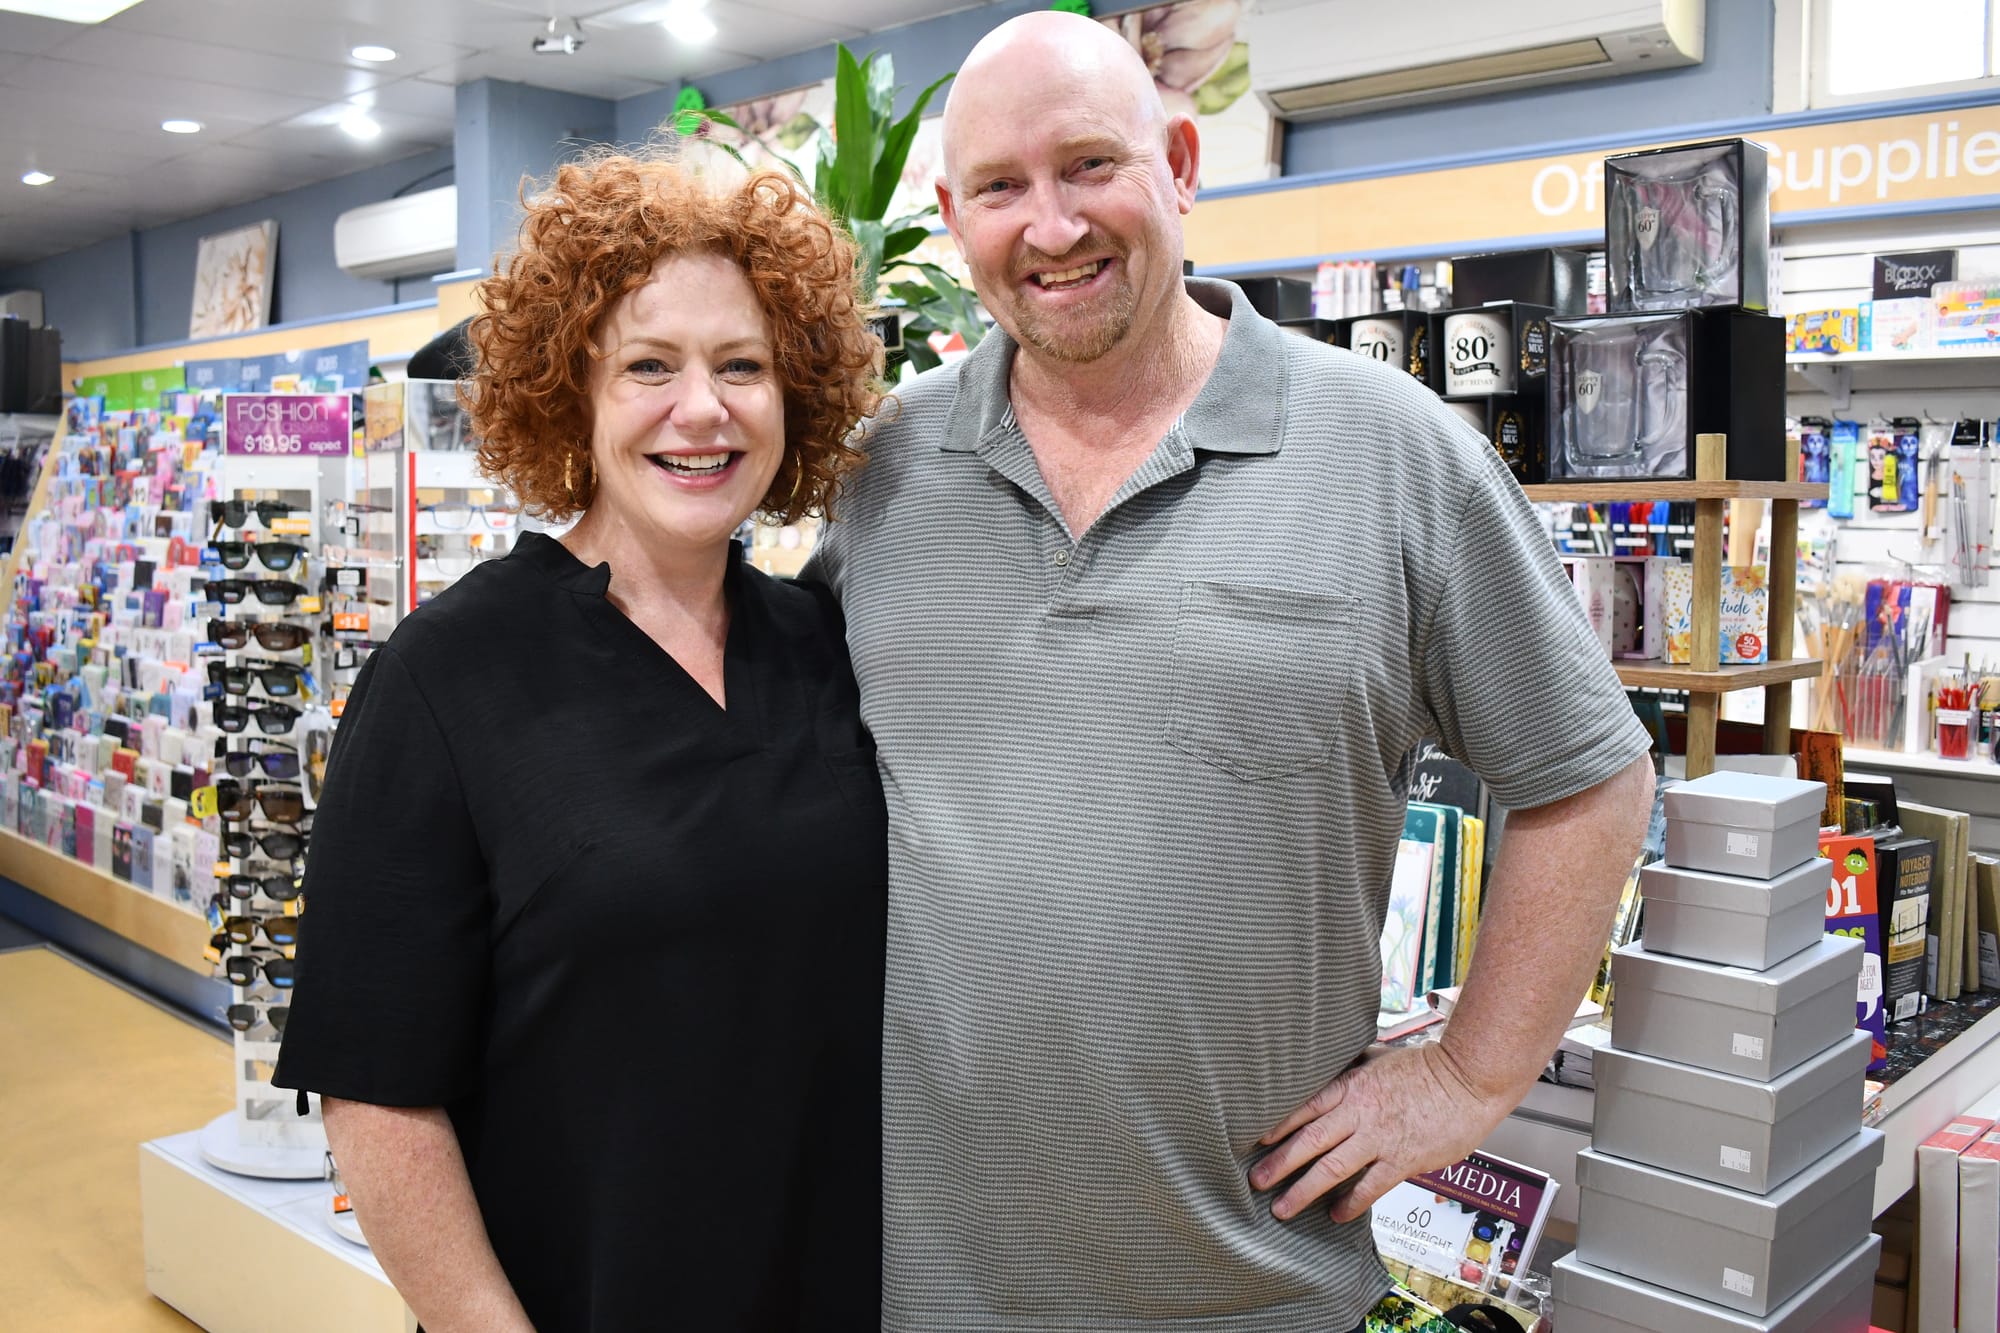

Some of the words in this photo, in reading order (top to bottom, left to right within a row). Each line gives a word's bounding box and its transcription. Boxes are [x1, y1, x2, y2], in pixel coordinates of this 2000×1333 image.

[1531, 164, 1604, 217] Of
[1455, 335, 1489, 361] 80
[244, 434, 302, 453] $19.95
[1743, 635, 1755, 646] 50
[1900, 854, 1931, 875] VOYAGER
[1899, 870, 1930, 889] NOTEBOOK
[1440, 1164, 1521, 1209] MEDIA
[1406, 1206, 1432, 1229] 60
[1376, 1213, 1454, 1250] HEAVYWEIGHT
